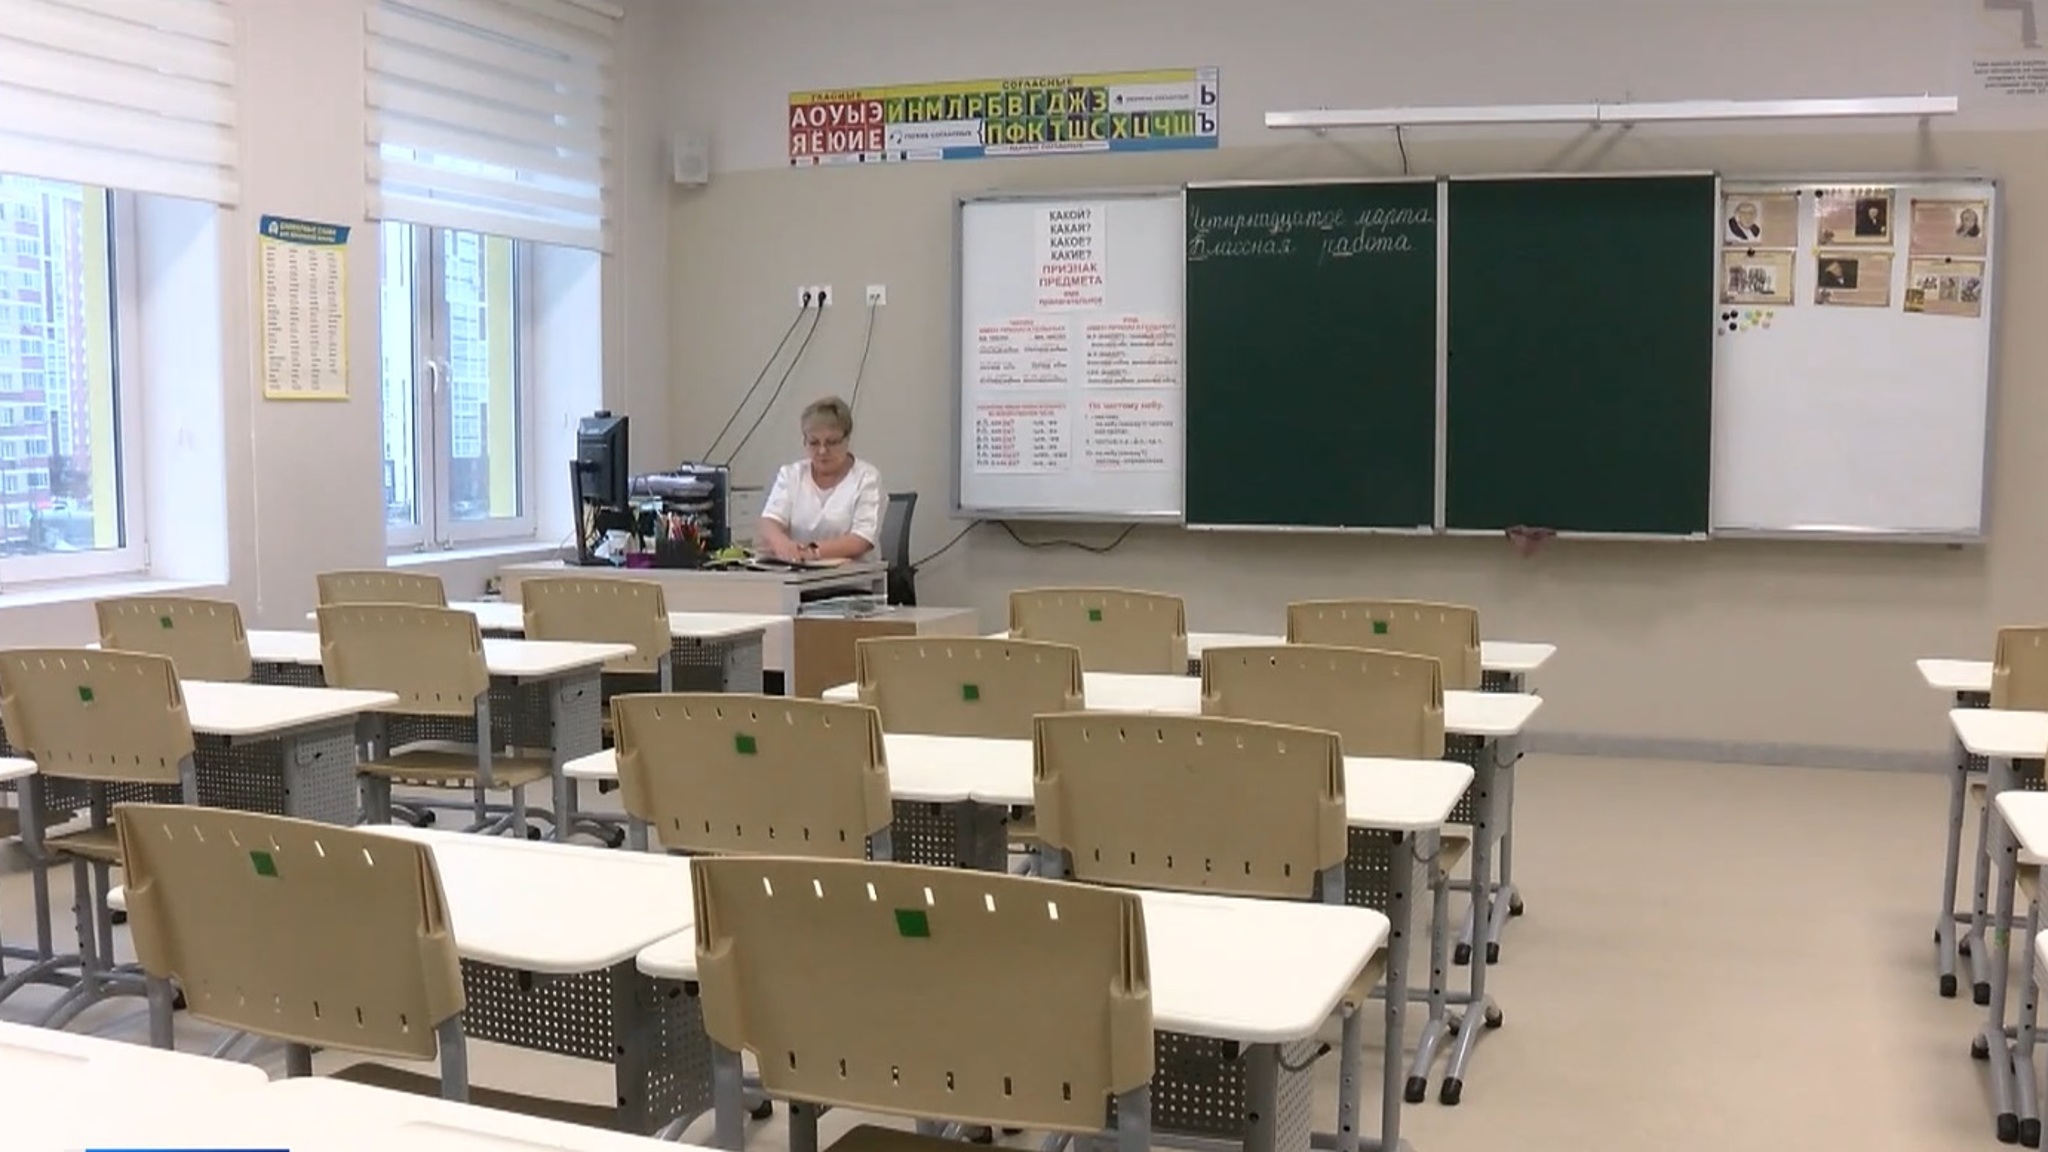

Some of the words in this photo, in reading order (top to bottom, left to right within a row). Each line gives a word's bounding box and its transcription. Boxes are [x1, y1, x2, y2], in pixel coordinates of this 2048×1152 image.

[1049, 209, 1091, 221] КАКОЙ?
[1050, 223, 1091, 234] КАКАЯ?
[1050, 236, 1092, 248] КАКОЕ?
[1051, 249, 1092, 261] КАКИЕ?
[1042, 263, 1097, 274] ПРИЗНАК
[1039, 275, 1103, 287] ПРЕДМЕТА
